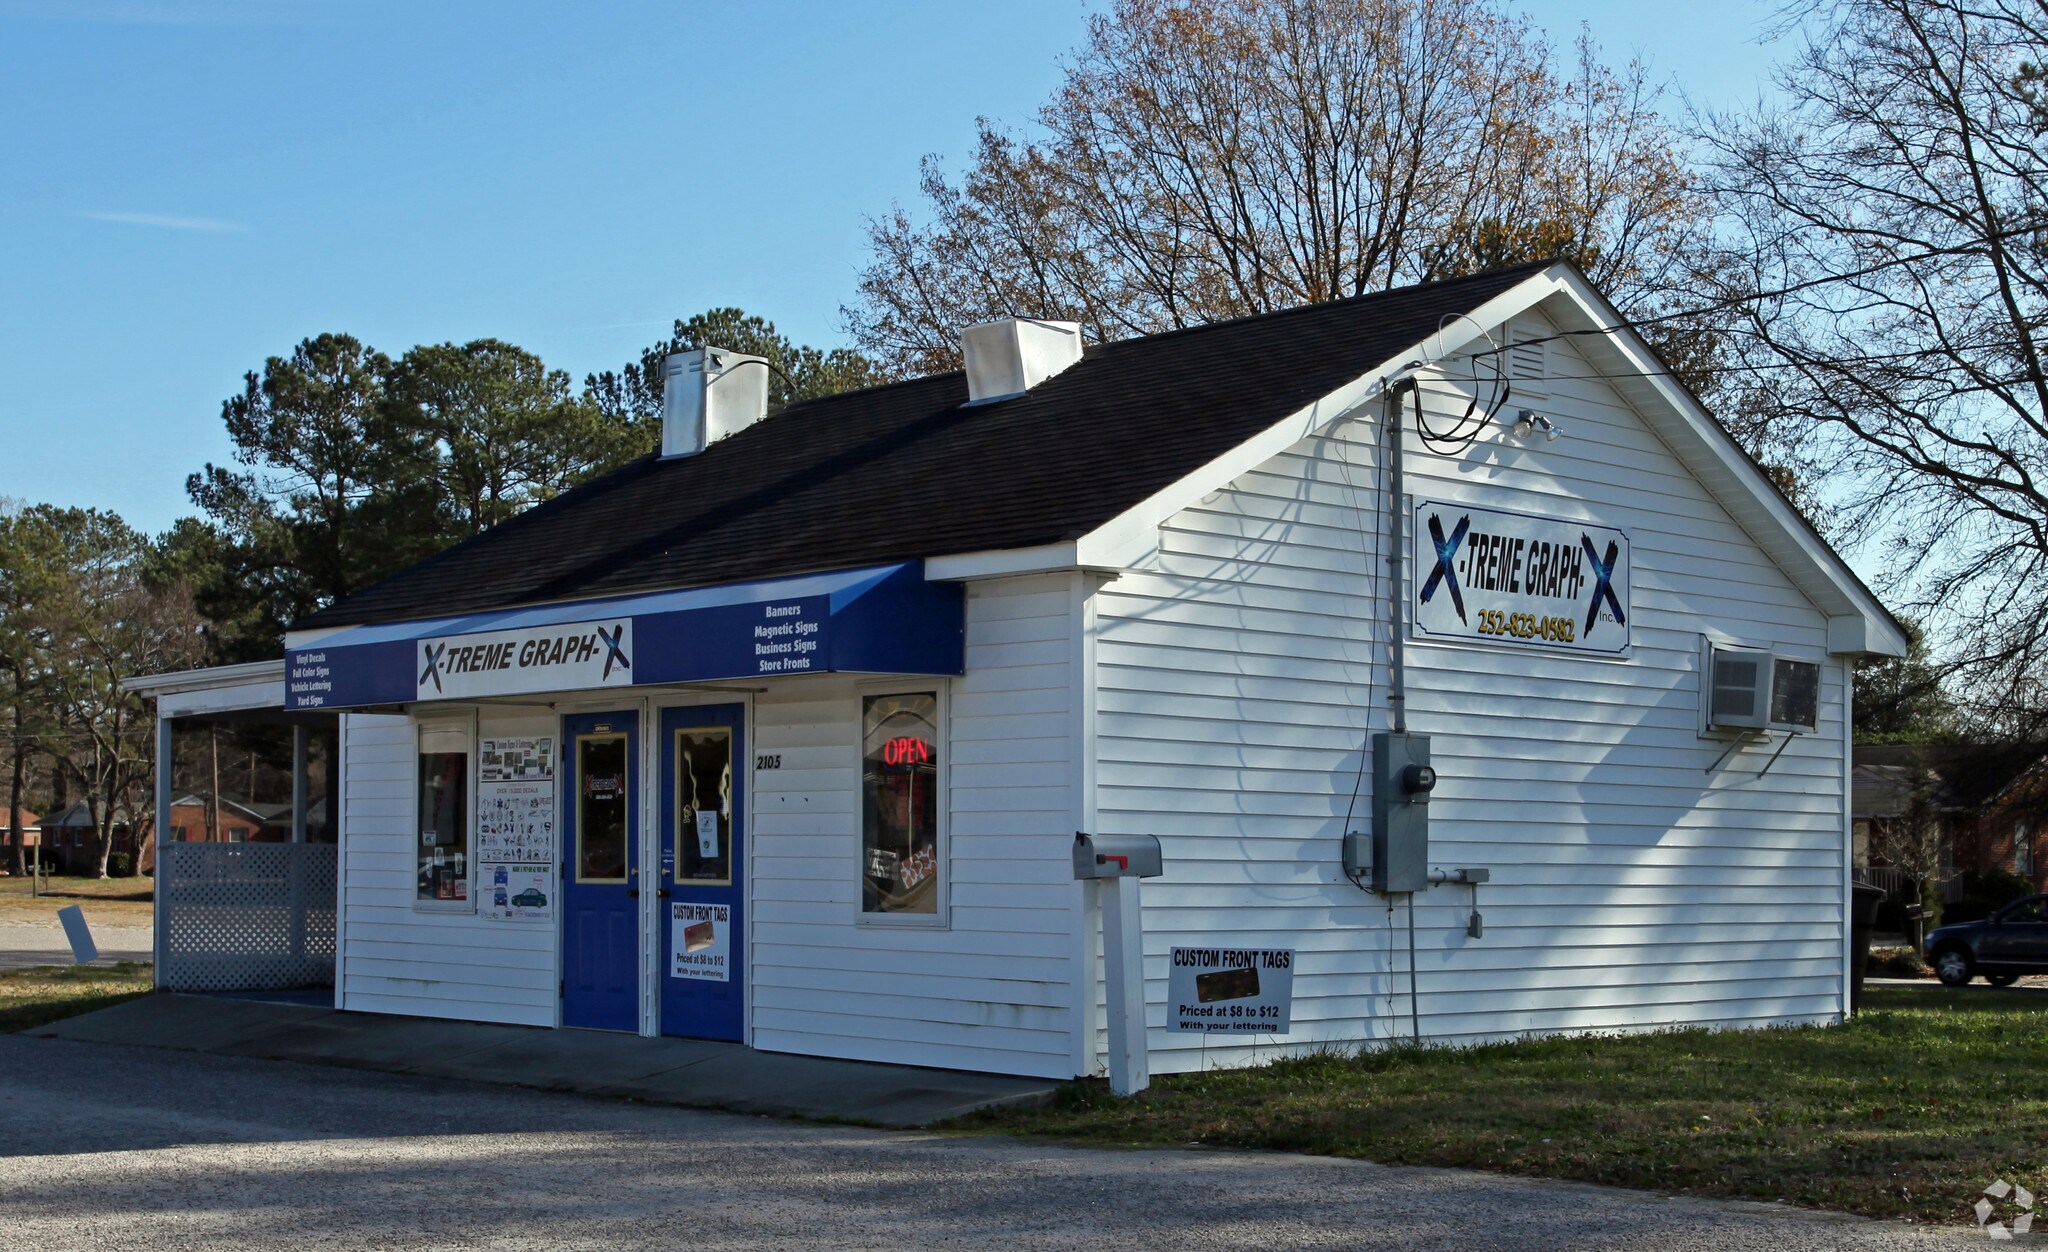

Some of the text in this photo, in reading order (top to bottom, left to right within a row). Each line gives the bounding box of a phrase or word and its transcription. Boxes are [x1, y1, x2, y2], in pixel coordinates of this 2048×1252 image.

[1420, 512, 1625, 639] X-TREME GRAPH-X
[766, 606, 801, 618] Banners
[754, 621, 818, 639] Magnetic Signs
[1477, 608, 1575, 643] 252-823-0582
[755, 639, 817, 655] Business Signs
[296, 652, 325, 665] Vinyl Decals
[419, 623, 630, 694] X-TREME GRAPH-X
[759, 657, 810, 672] Store Fronts
[292, 666, 329, 678] Full Color Signs
[291, 680, 331, 692] Vehicle Lettering
[297, 695, 323, 706] Yard Signs
[884, 737, 928, 765] OPEN
[756, 754, 781, 770] 2105
[673, 904, 728, 923] CUSTOM FRONT TAGS
[676, 953, 724, 966] Priced at $8 to $12
[1174, 949, 1290, 968] CUSTOM FRONT TAGS
[677, 967, 689, 975] With
[701, 969, 724, 979] lettering
[1179, 1004, 1279, 1018] Priced at $8 to $12
[1180, 1021, 1277, 1031] With your lettering
